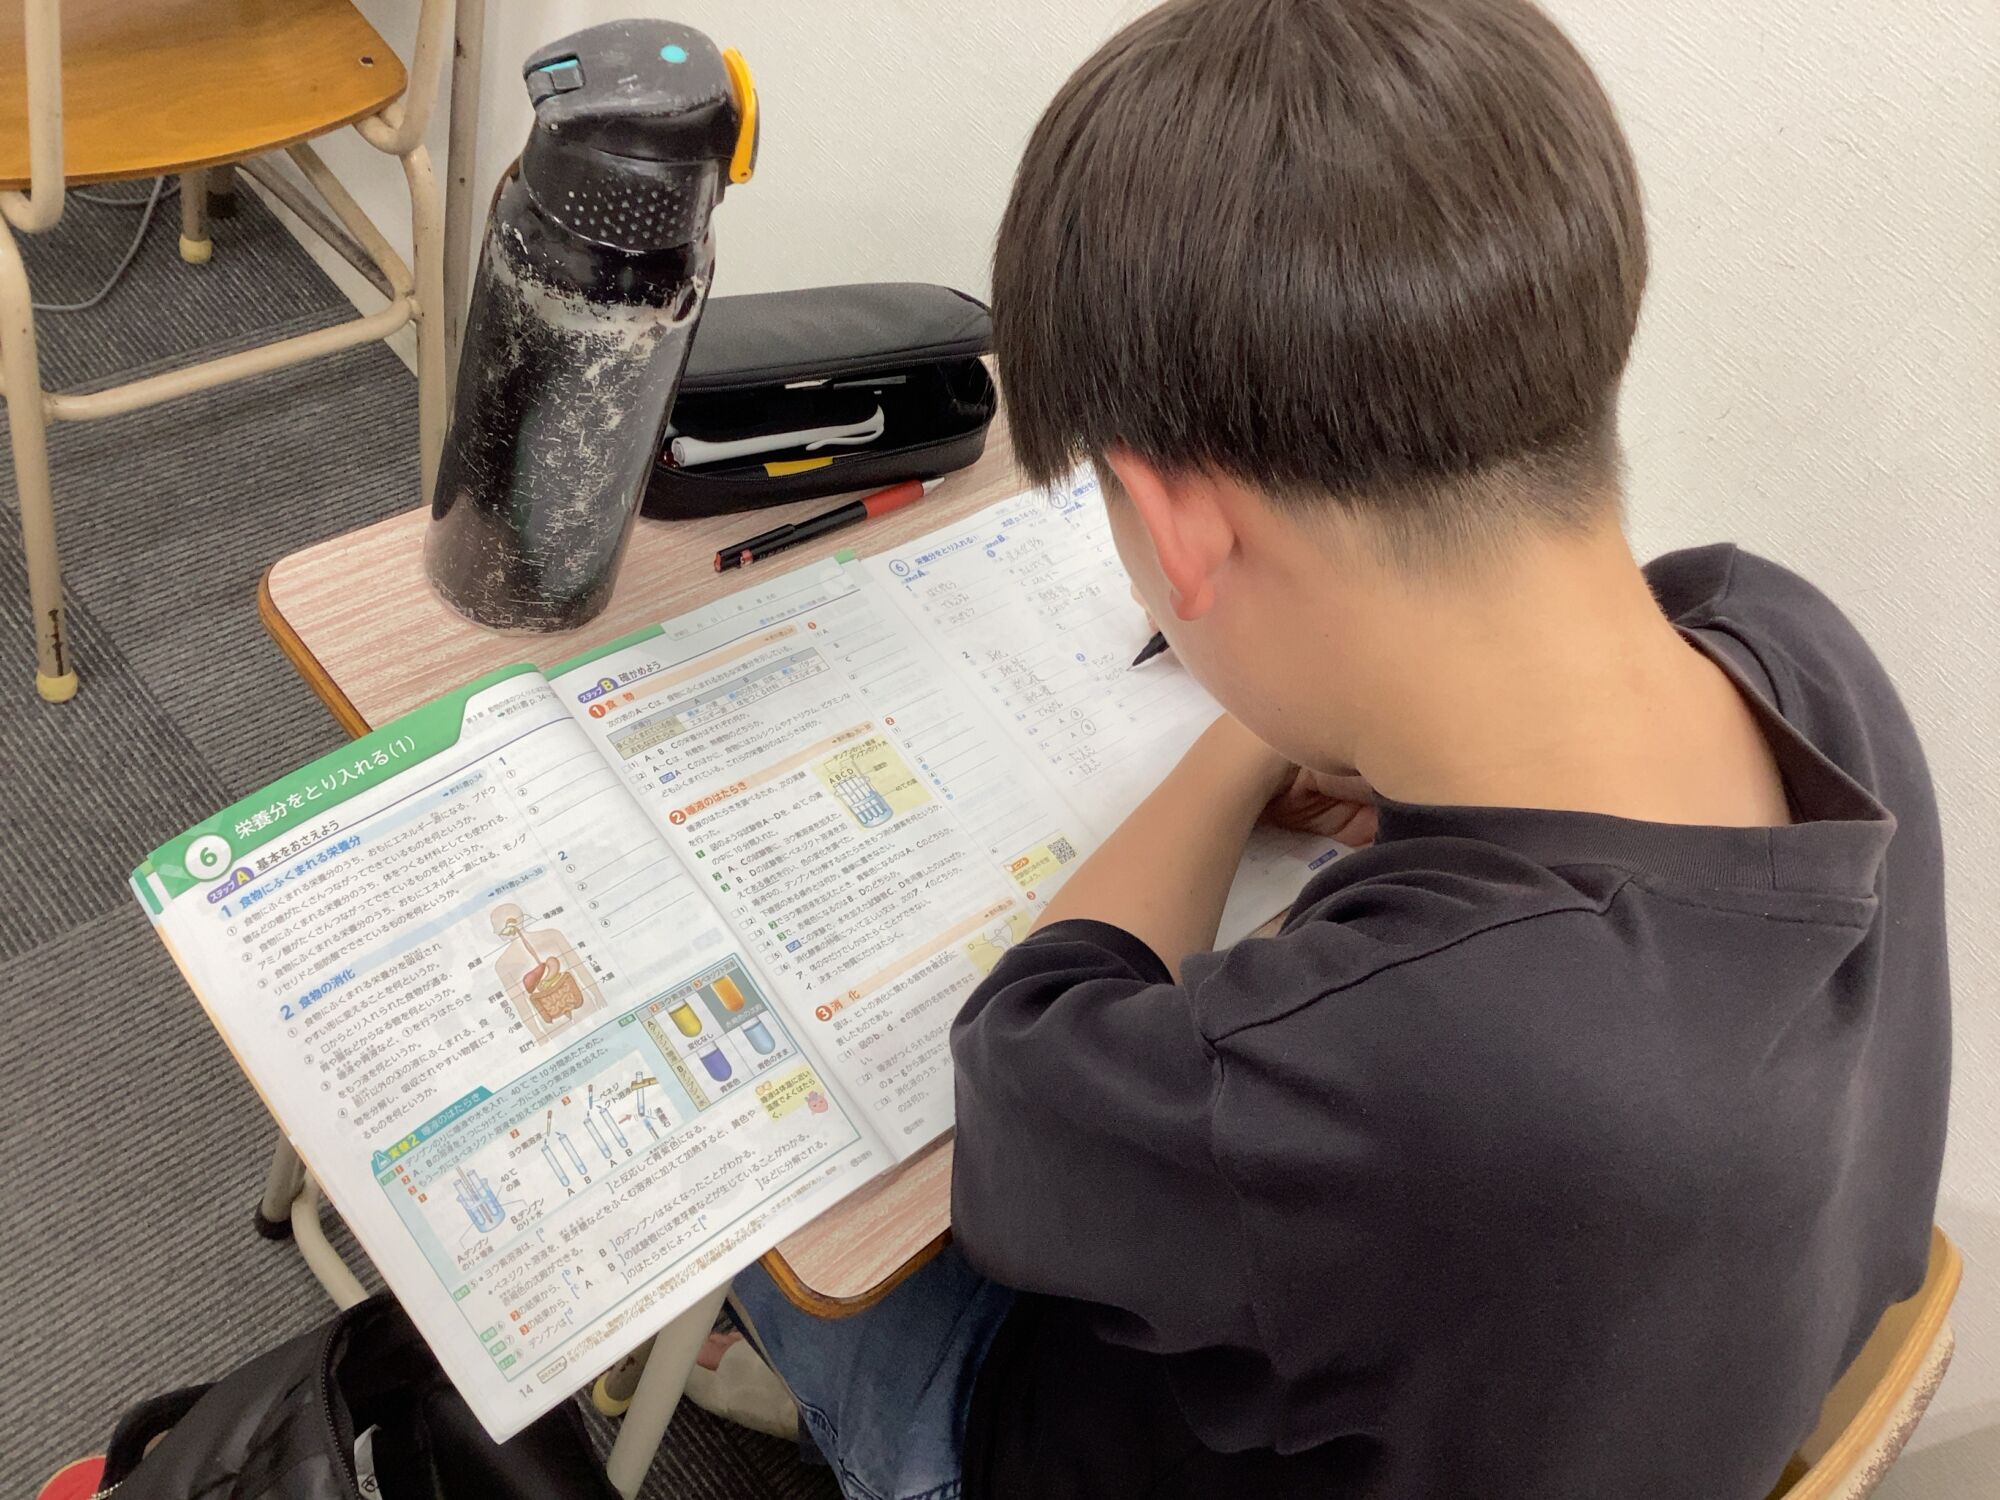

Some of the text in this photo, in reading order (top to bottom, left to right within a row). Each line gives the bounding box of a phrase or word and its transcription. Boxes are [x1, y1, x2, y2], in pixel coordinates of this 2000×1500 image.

[617, 659, 662, 684] 確かめよう
[231, 733, 419, 841] 栄養分をとり入れる(1)
[194, 845, 220, 869] 6
[253, 818, 342, 872] 基本をおさえよう
[556, 849, 568, 861] 2
[220, 833, 364, 918] 1 食物にふくまれる栄養分
[277, 966, 356, 1020] 2 食物の消化
[517, 1382, 535, 1400] 14
